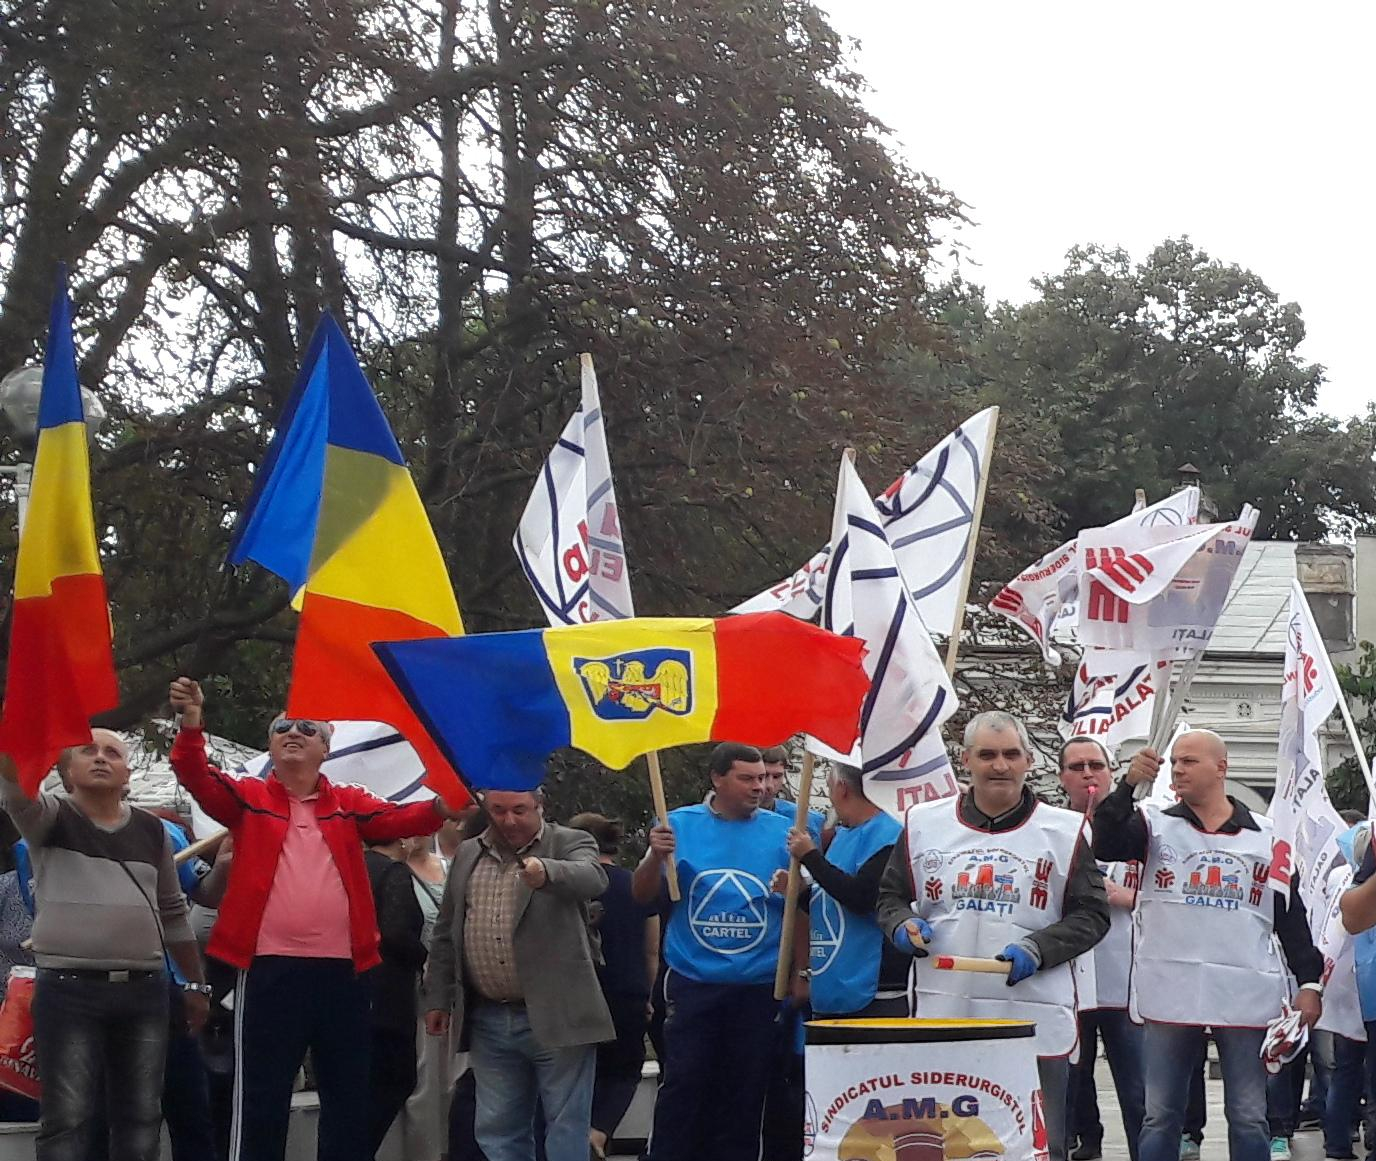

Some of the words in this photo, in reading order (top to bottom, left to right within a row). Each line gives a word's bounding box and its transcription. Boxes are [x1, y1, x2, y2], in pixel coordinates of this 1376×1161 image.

[703, 926, 752, 938] CARTEL
[821, 1074, 905, 1134] SINDICATUL
[911, 1072, 1027, 1136] SIDERURGISTUL
[863, 1094, 980, 1120] A.M.G
